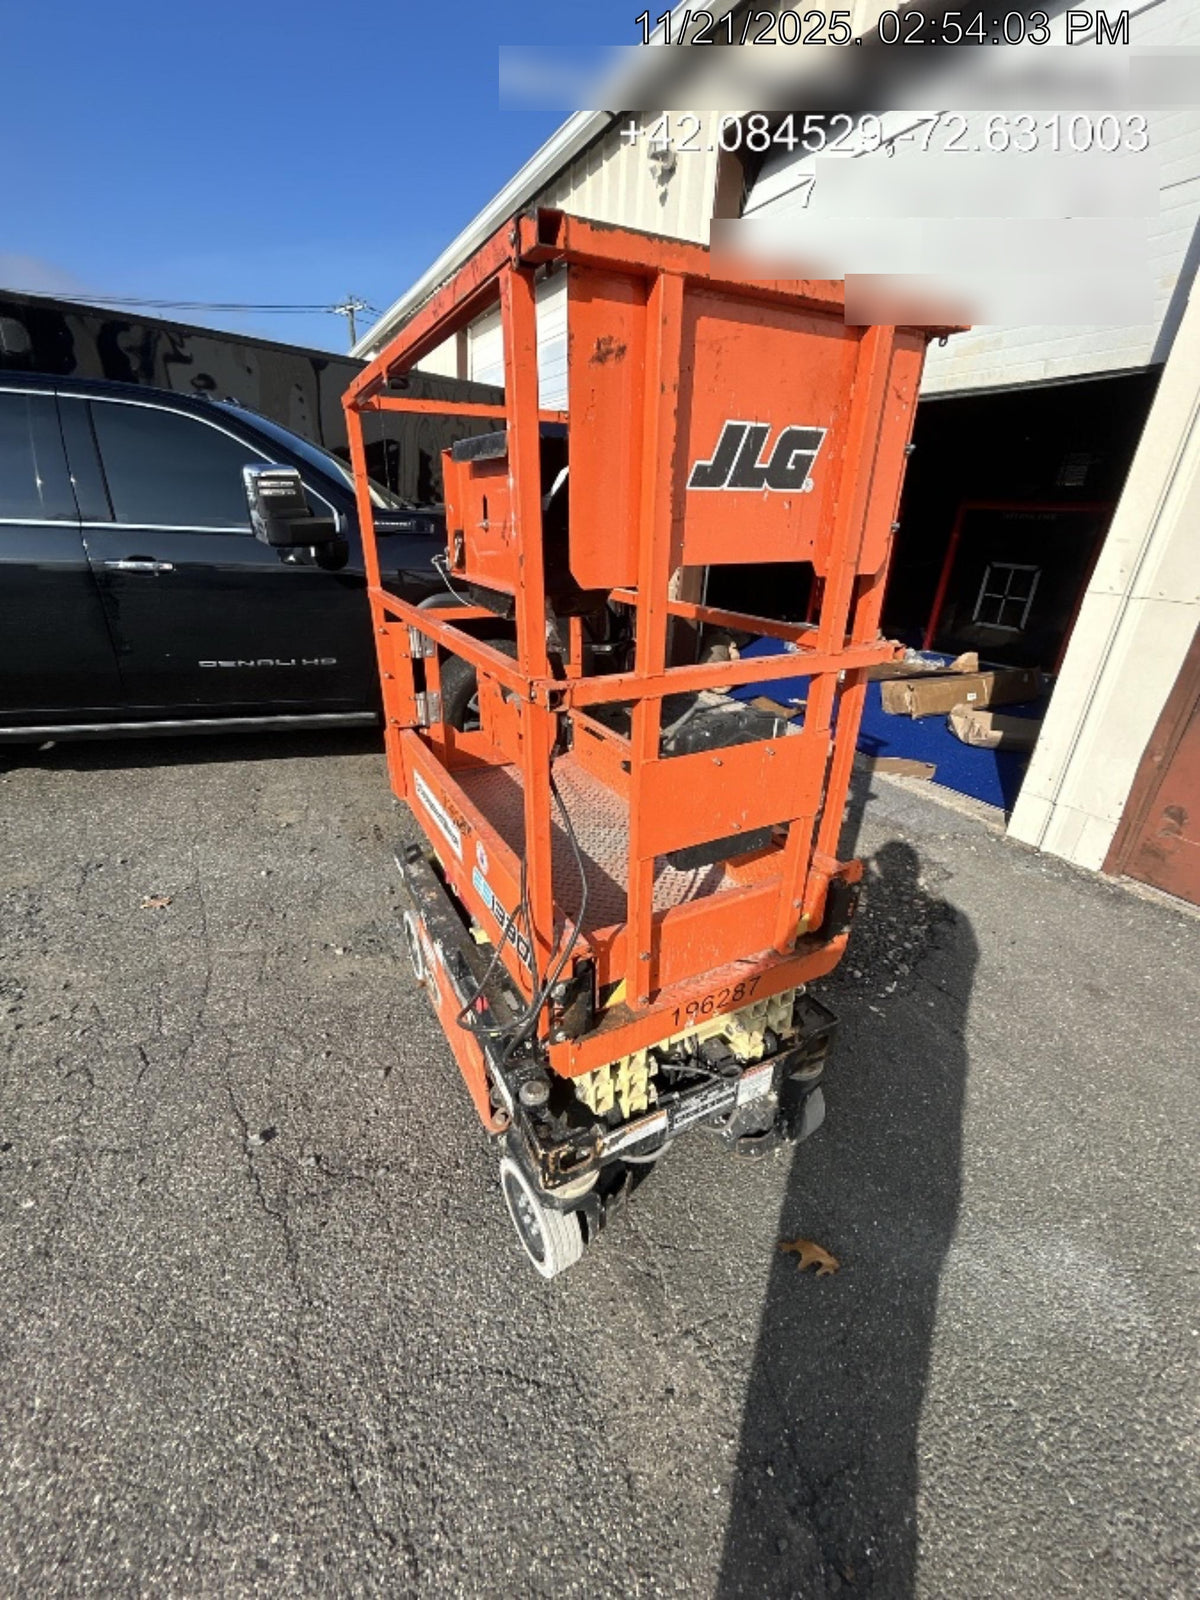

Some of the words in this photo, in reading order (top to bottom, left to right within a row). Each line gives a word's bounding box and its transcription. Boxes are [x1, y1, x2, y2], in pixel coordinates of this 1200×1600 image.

[686, 419, 828, 493] JLG
[198, 659, 297, 668] DENALI
[672, 975, 762, 1027] 196287
